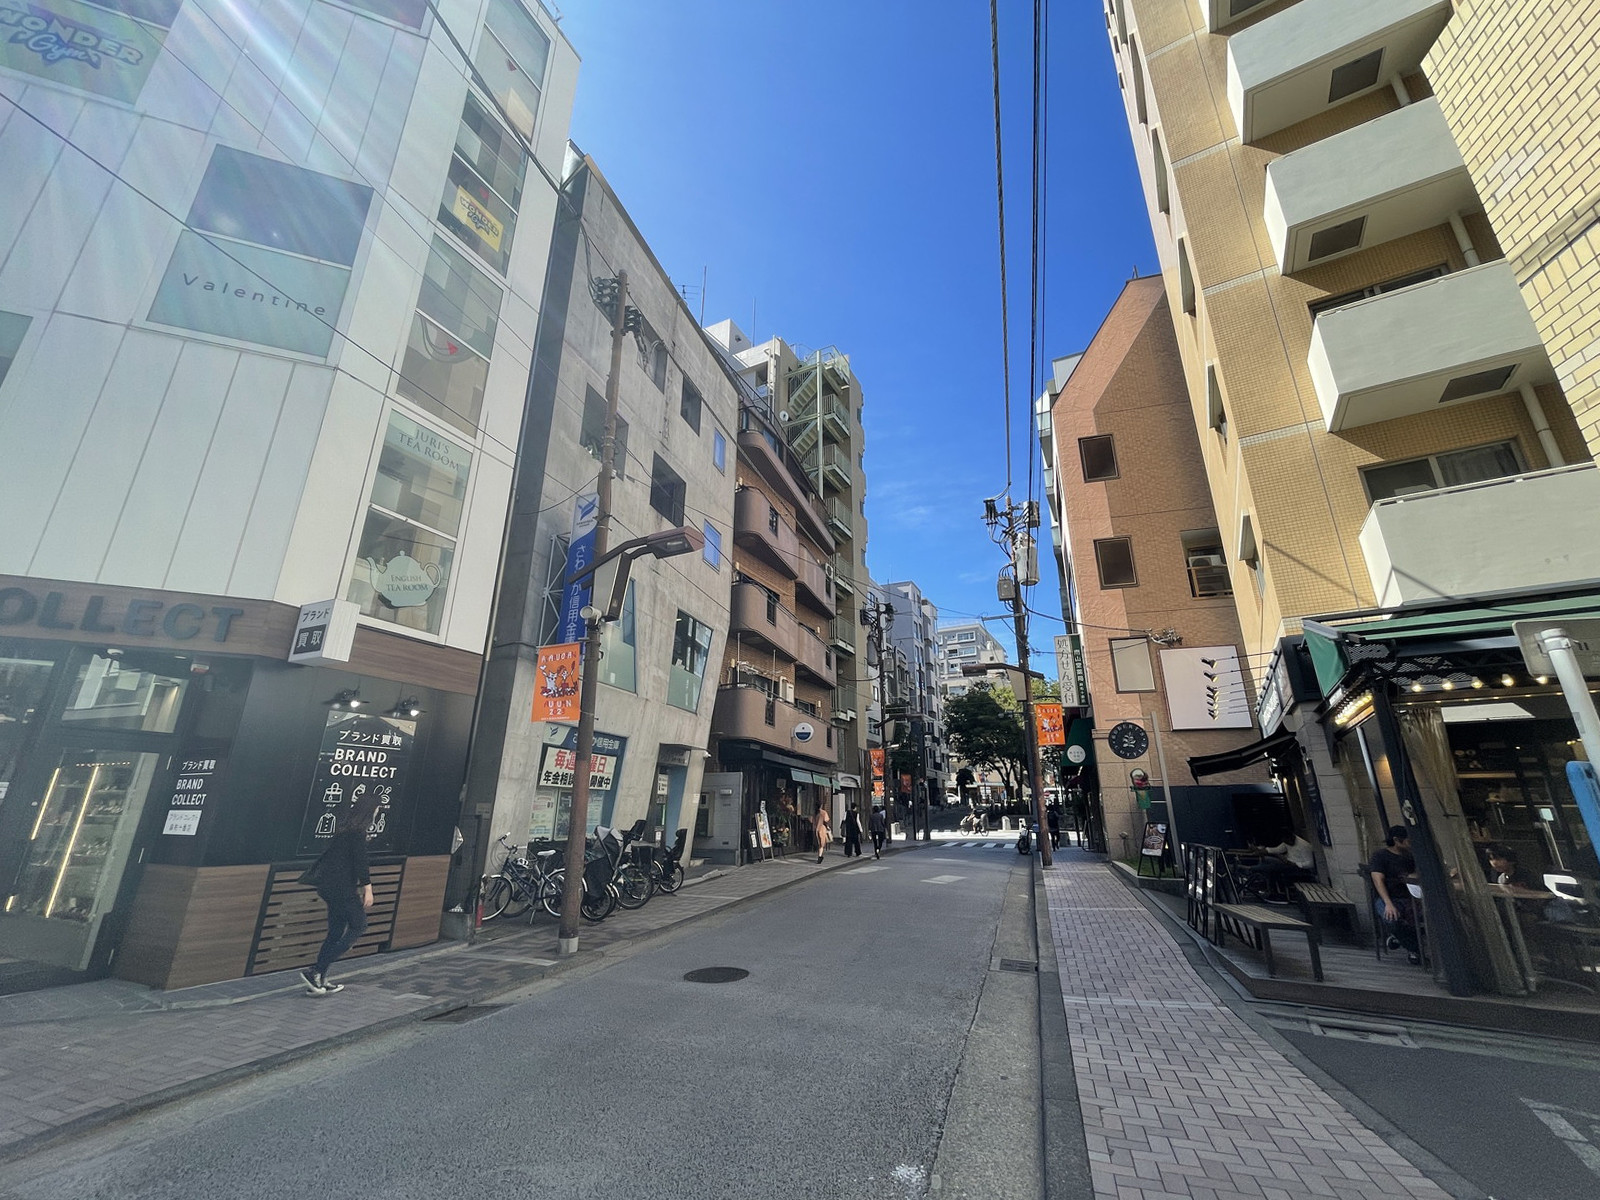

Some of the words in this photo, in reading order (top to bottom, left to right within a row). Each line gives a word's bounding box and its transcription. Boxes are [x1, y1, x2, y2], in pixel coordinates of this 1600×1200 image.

[183, 273, 326, 316] Valentine
[415, 429, 450, 455] JURI'S
[399, 433, 421, 452] TEA
[424, 446, 459, 471] ROOM
[387, 583, 401, 591] TEA
[402, 583, 429, 591] ROOM
[302, 607, 331, 622] ブランド
[296, 630, 322, 648] 買取
[339, 730, 402, 746] ブランド買取
[334, 748, 387, 763] BRAND
[330, 763, 397, 778] COLLECT
[176, 779, 204, 790] BRAND
[171, 794, 207, 805] COLLECT
